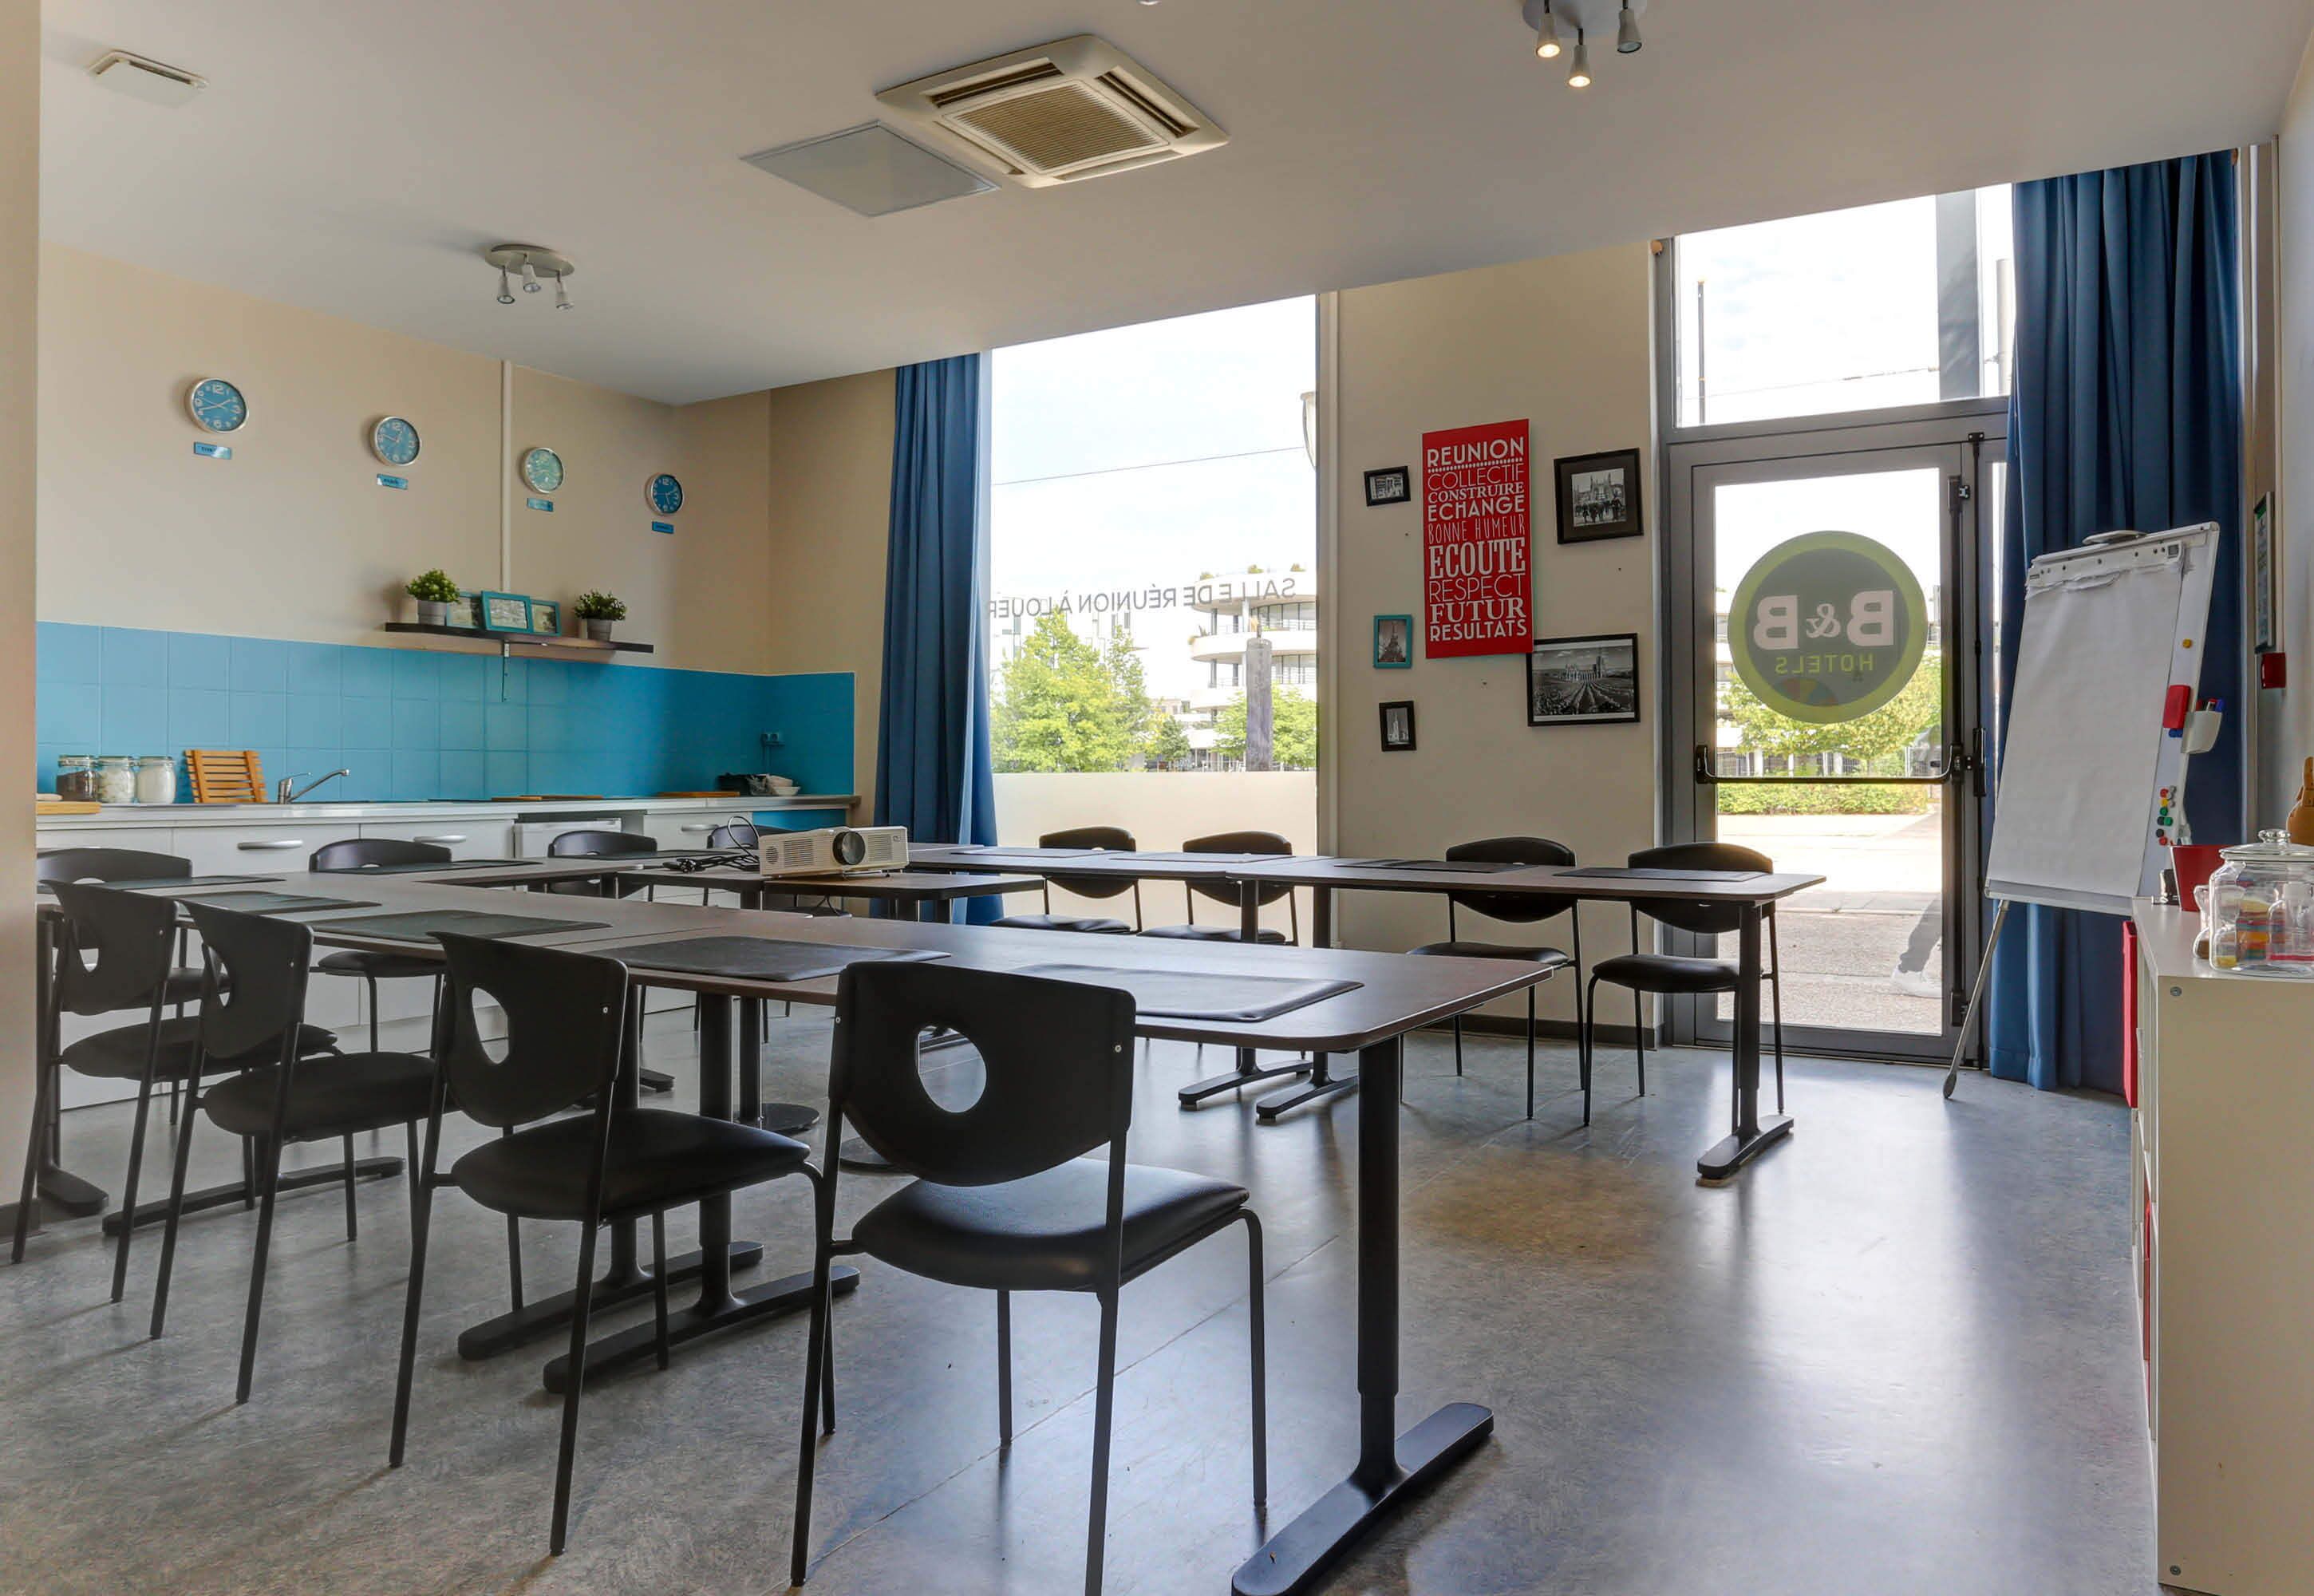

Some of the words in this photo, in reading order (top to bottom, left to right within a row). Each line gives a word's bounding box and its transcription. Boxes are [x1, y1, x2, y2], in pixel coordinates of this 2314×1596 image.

[1427, 437, 1524, 467] REUNION
[1427, 463, 1524, 491] COLLECTIF
[1427, 481, 1524, 503] CONSTRUIRE
[1427, 495, 1525, 522] ECHANGE
[1428, 520, 1467, 544] BONNE
[1475, 513, 1525, 539] HUMEUR
[1429, 537, 1526, 579] ECOUTE
[1429, 573, 1526, 602] RESPECT
[1430, 598, 1526, 625] FUTUR
[1429, 618, 1527, 642] RESULTATS
